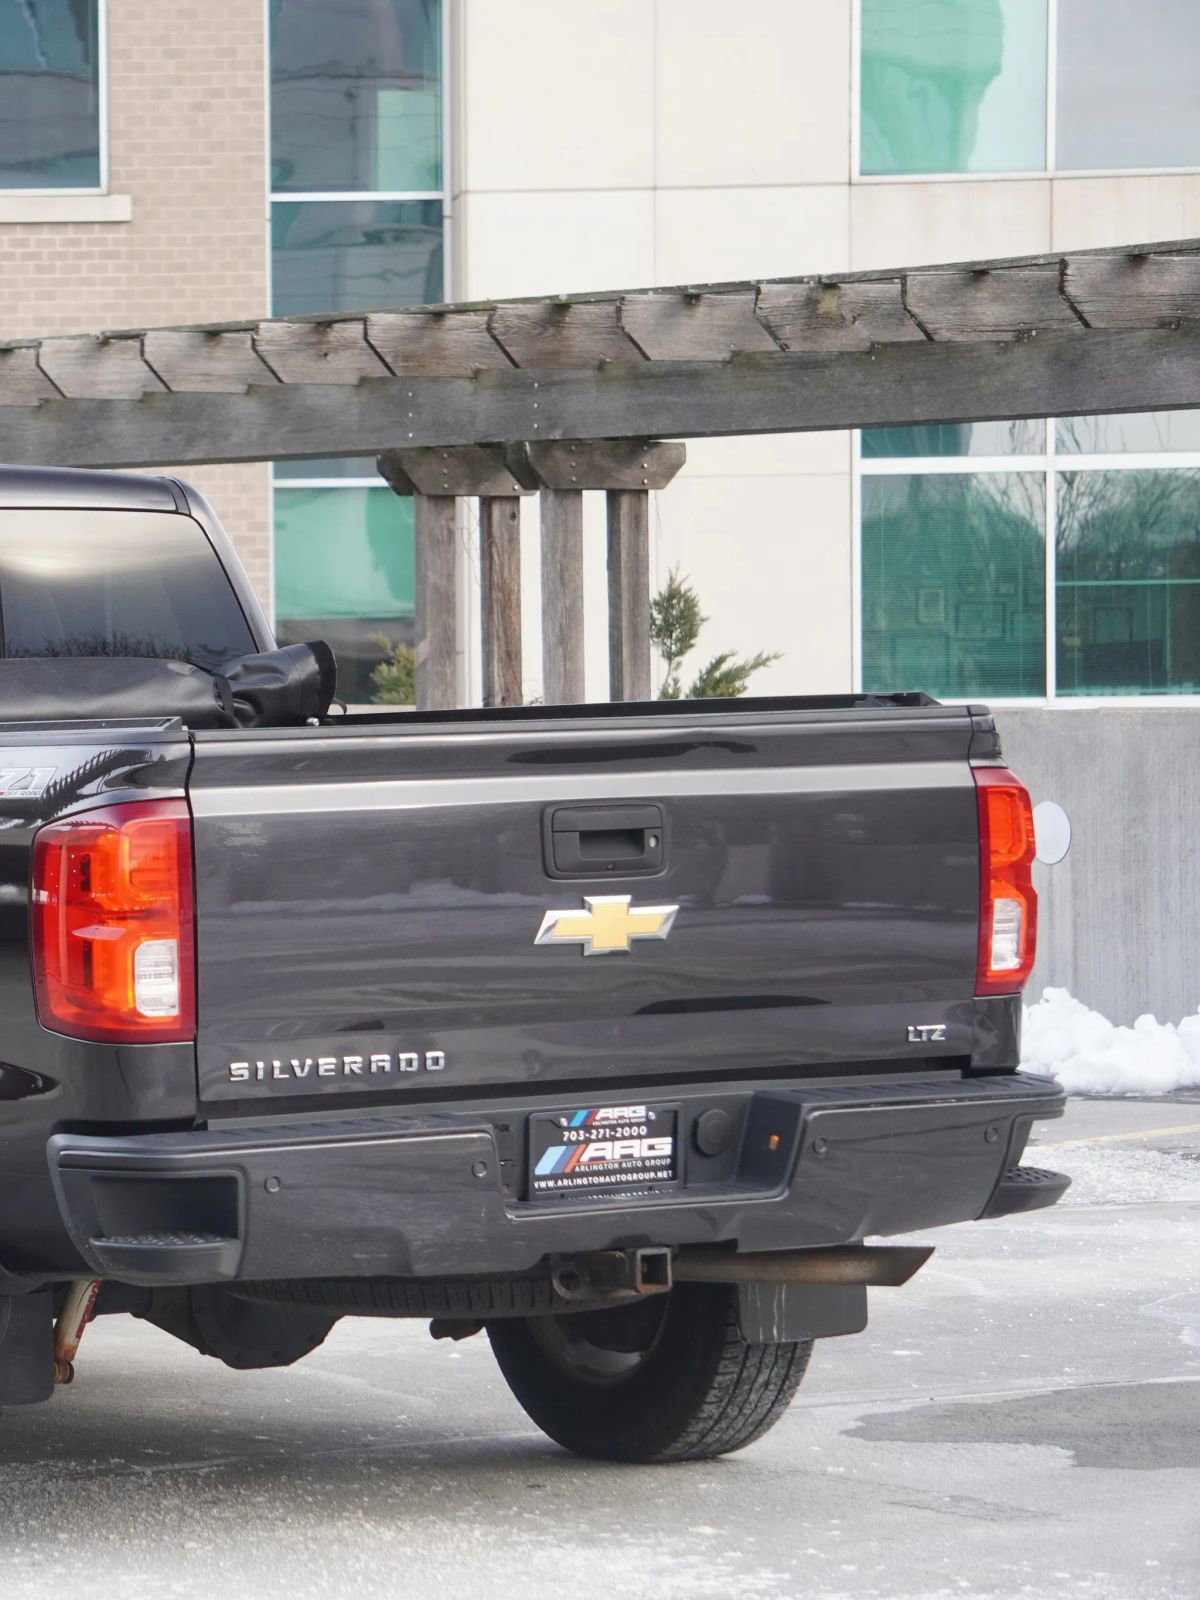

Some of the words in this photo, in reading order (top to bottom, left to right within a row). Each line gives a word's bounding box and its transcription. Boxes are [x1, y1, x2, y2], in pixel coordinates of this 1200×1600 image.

[907, 1024, 946, 1042] LTZ
[229, 1051, 445, 1082] SILVERADO
[562, 1125, 648, 1141] 703-271-2000
[580, 1137, 673, 1162] AAG
[574, 1162, 619, 1172] ARLINGTON
[621, 1160, 643, 1169] AUTO
[644, 1157, 672, 1166] GROUP
